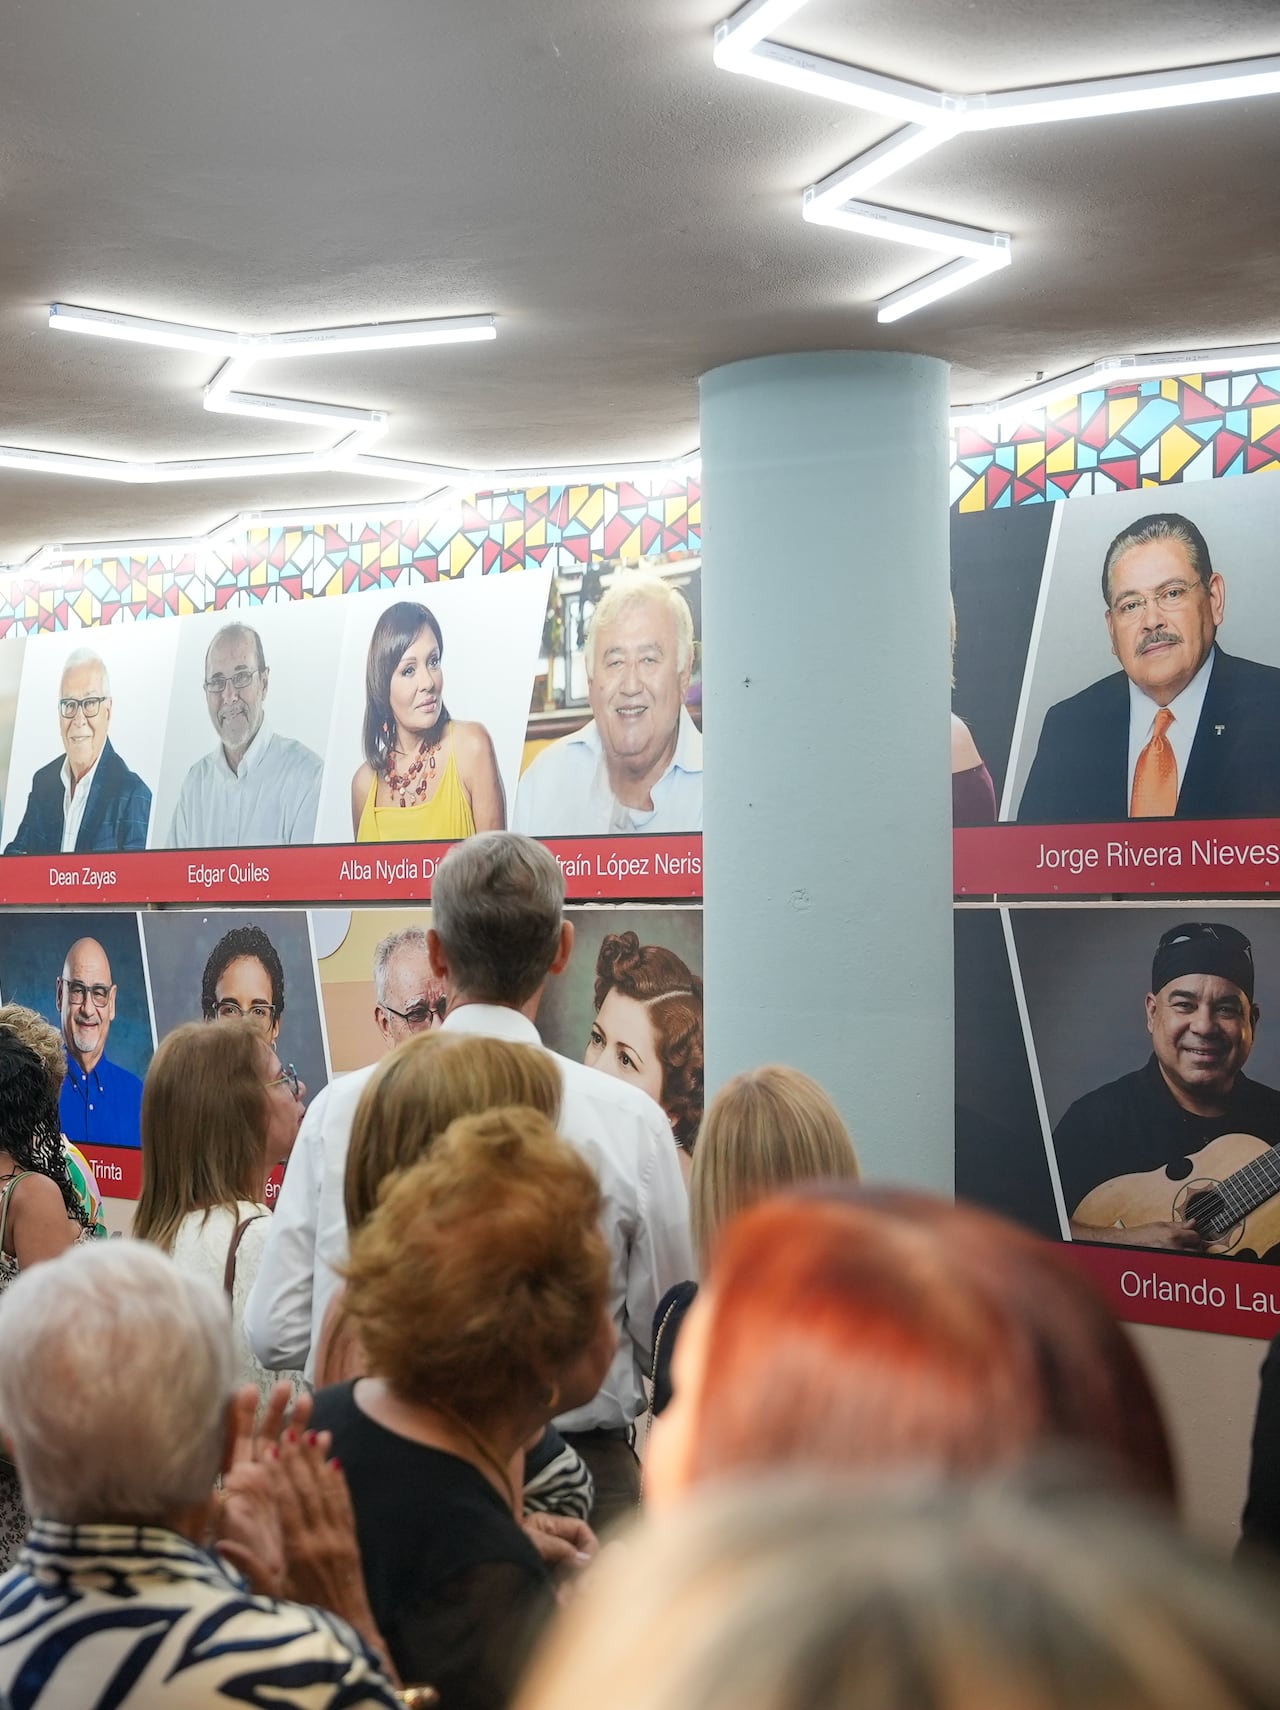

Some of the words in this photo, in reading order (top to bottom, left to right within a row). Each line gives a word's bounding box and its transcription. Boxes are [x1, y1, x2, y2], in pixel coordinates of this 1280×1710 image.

[555, 854, 591, 876] fraín
[597, 853, 649, 881] López
[655, 851, 701, 875] Neris
[1036, 843, 1099, 874] Jorge
[1107, 841, 1182, 867] Rivera
[1191, 838, 1280, 866] Nieves
[49, 868, 79, 886] Dean
[82, 868, 117, 889] Zayas
[188, 863, 225, 888] Edgar
[228, 862, 270, 884] Quiles
[340, 860, 371, 881] Alba
[376, 858, 418, 884] Nydia
[422, 857, 440, 879] Dí
[89, 1159, 122, 1181] Trinta
[1120, 1270, 1226, 1308] Orlando
[1236, 1283, 1280, 1315] Lau
